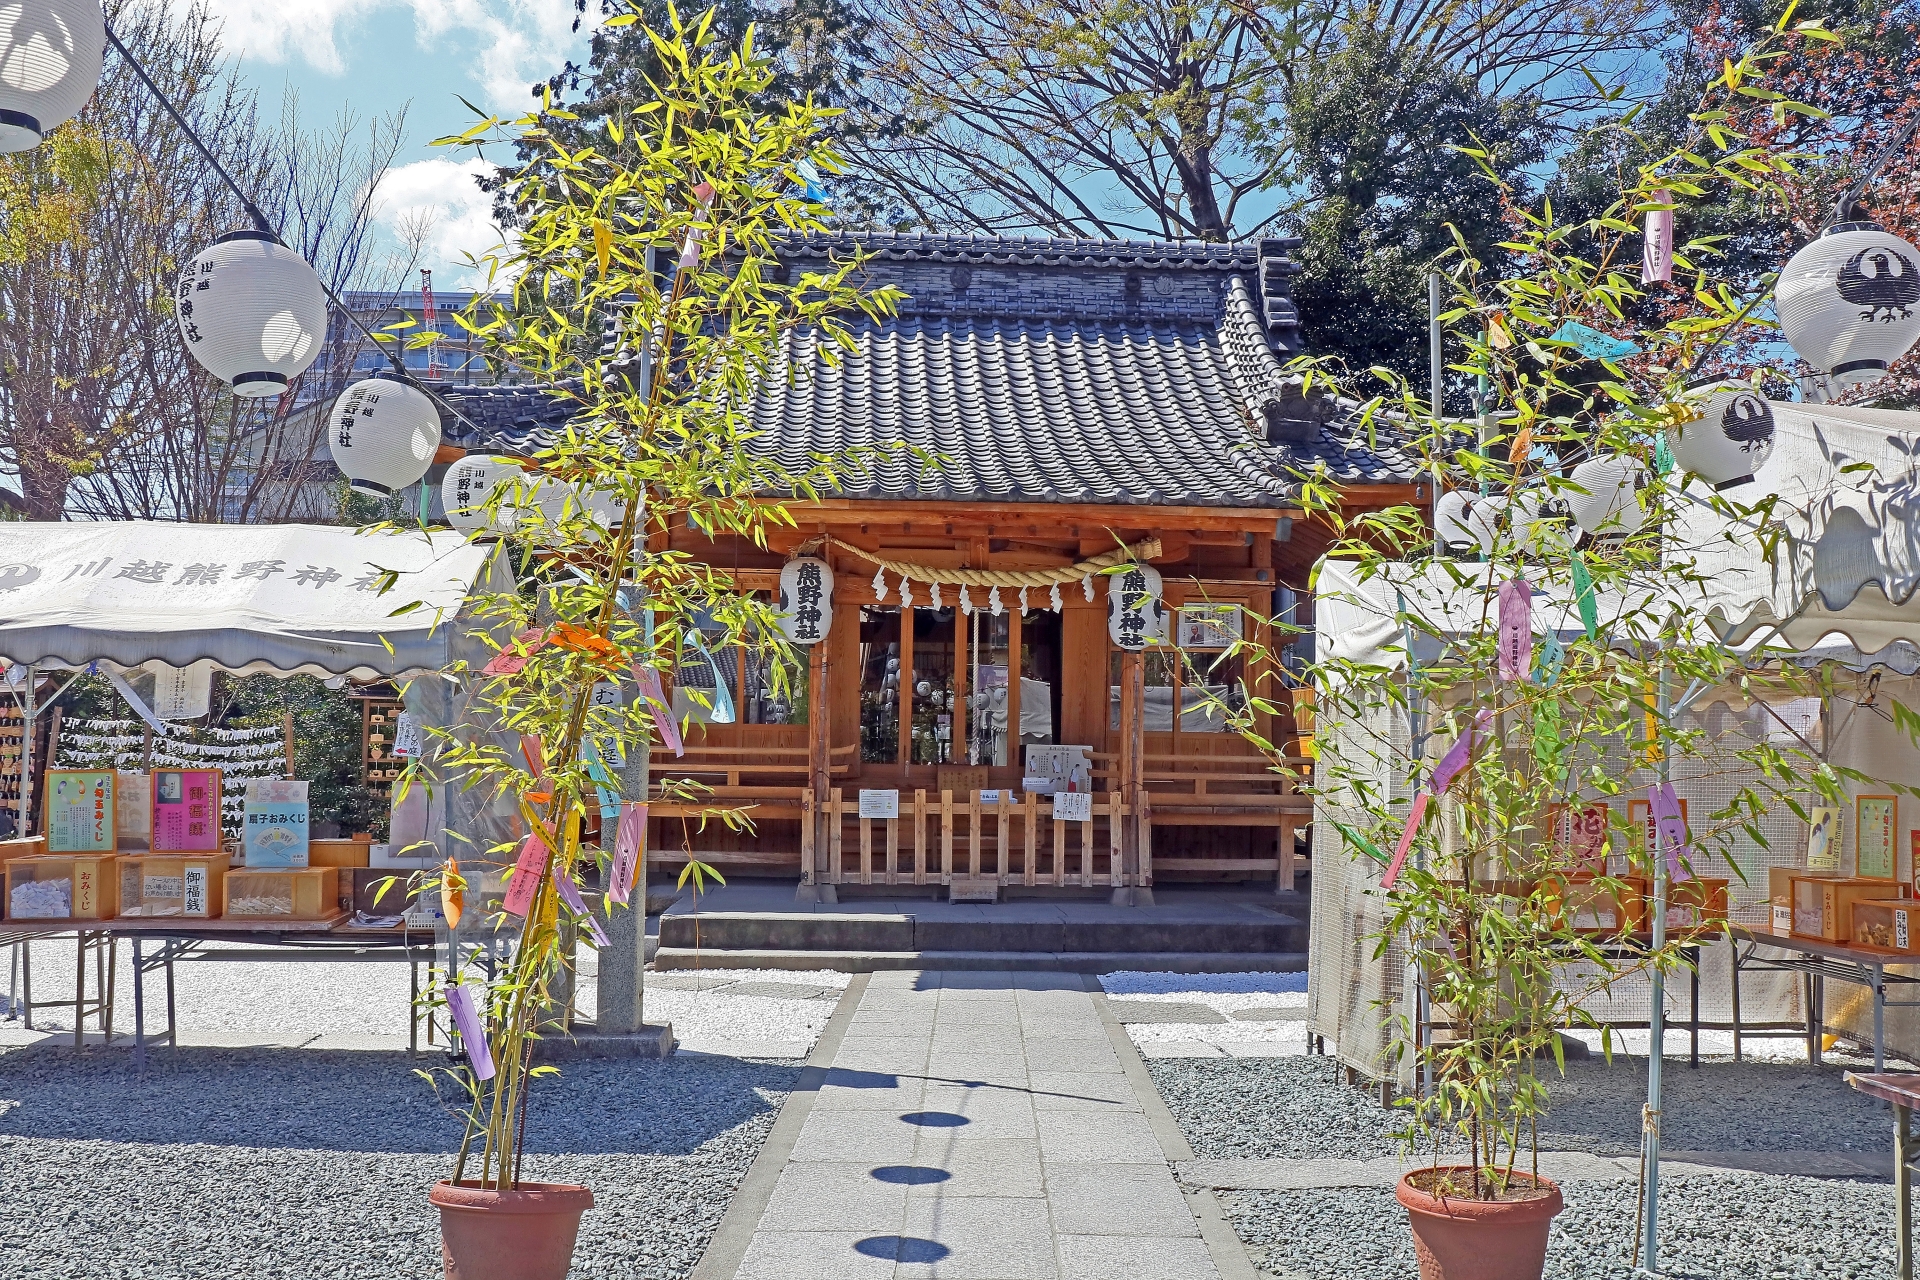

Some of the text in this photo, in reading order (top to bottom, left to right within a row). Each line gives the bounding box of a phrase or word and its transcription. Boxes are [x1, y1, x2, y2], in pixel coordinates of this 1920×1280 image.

[338, 388, 368, 448] 熊野神社
[362, 394, 380, 418] 川越
[473, 469, 485, 489] 川越
[58, 556, 397, 593] 川越熊野神社
[794, 562, 824, 639] 熊野神社
[1118, 569, 1147, 646] 熊野神社
[189, 786, 204, 836] 御福銭
[249, 814, 306, 824] 扇子おみくじ
[81, 872, 91, 911] おみくじ
[186, 871, 201, 912] 御福銭
